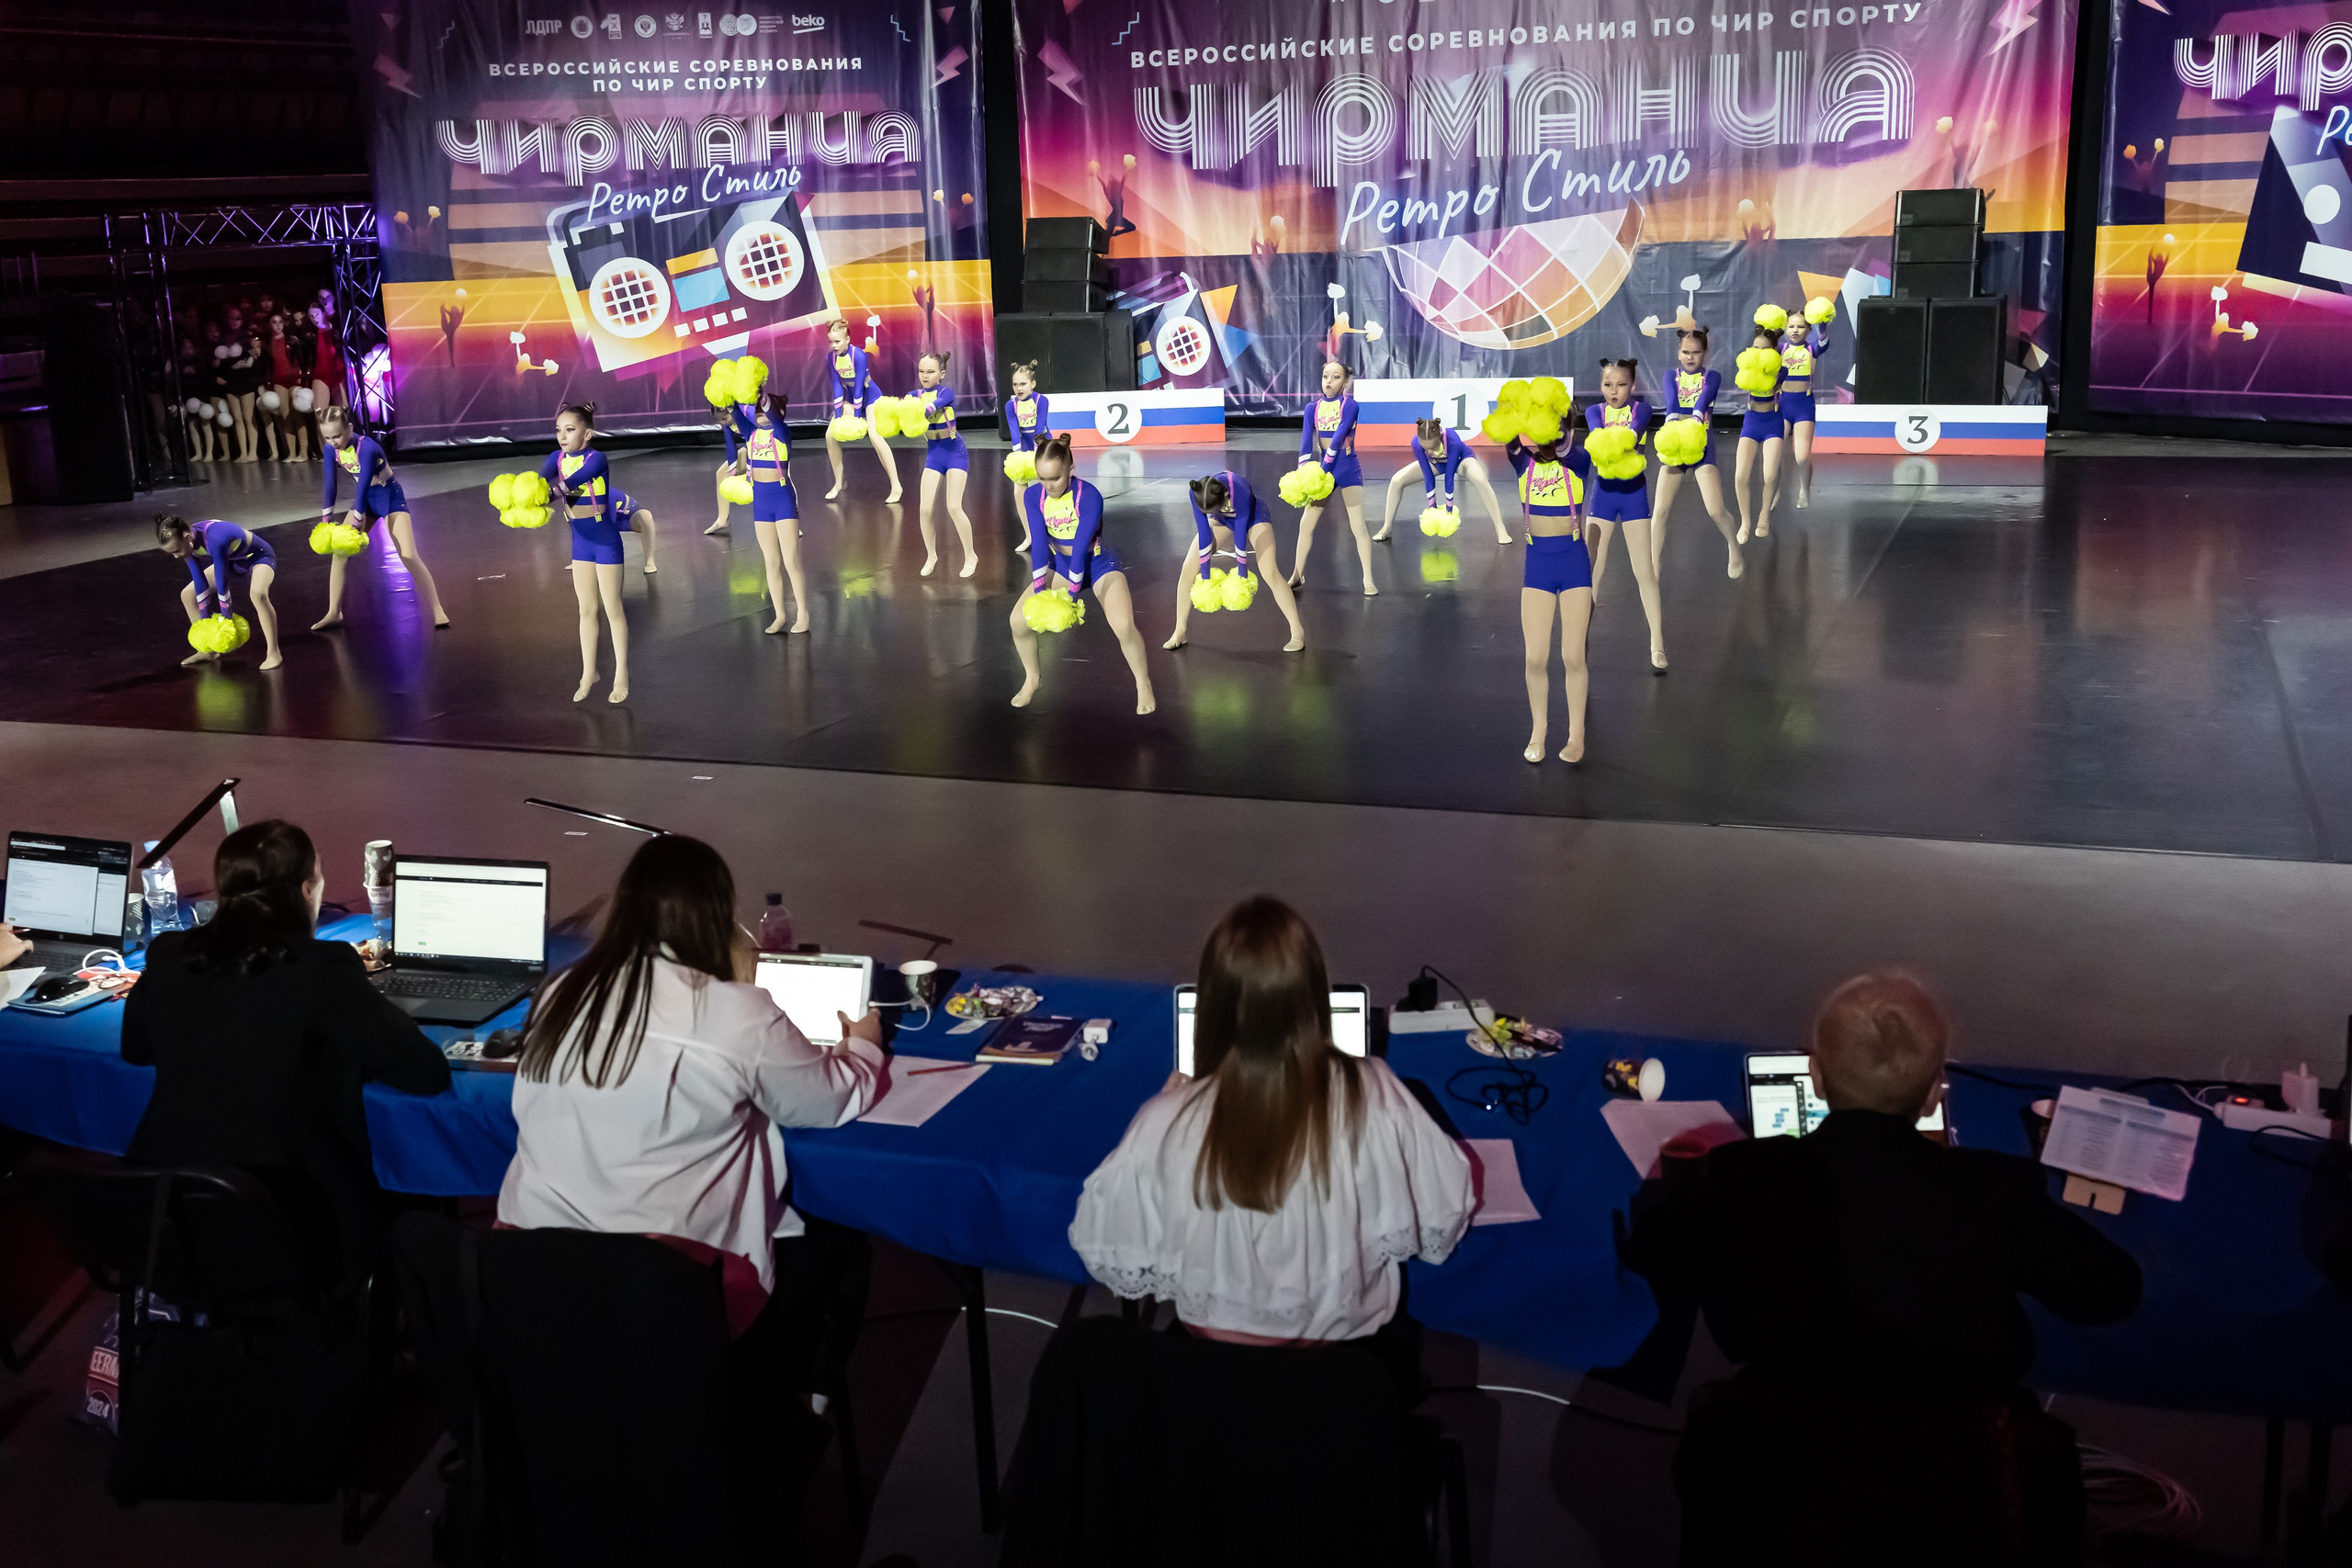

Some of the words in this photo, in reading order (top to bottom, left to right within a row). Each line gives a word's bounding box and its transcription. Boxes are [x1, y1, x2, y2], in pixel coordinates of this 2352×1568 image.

[526, 20, 562, 36] ЛДПР
[791, 14, 825, 27] beko
[1131, 37, 1374, 68] ВСЕРОССИЙСКИЕ
[1388, 20, 1636, 52] СОРЕВНОВАНИЯ
[1654, 17, 1695, 37] ПО
[1711, 12, 1774, 32] ЧИР
[1791, 3, 1922, 28] СПОРТУ
[489, 58, 680, 76] ВСЕРОССИЙСКИЕ
[689, 57, 862, 73] СОРЕВНОВАНИЯ
[593, 79, 622, 93] ПО
[631, 78, 674, 92] ЧИР
[684, 76, 767, 90] СПОРТУ
[587, 182, 688, 221] Ретро
[702, 164, 802, 202] Стиль
[1340, 181, 1500, 245] Ретро
[1521, 148, 1691, 213] Стиль
[1106, 402, 1130, 434] 2
[1450, 393, 1472, 431] 1
[1905, 414, 1929, 445] 3
